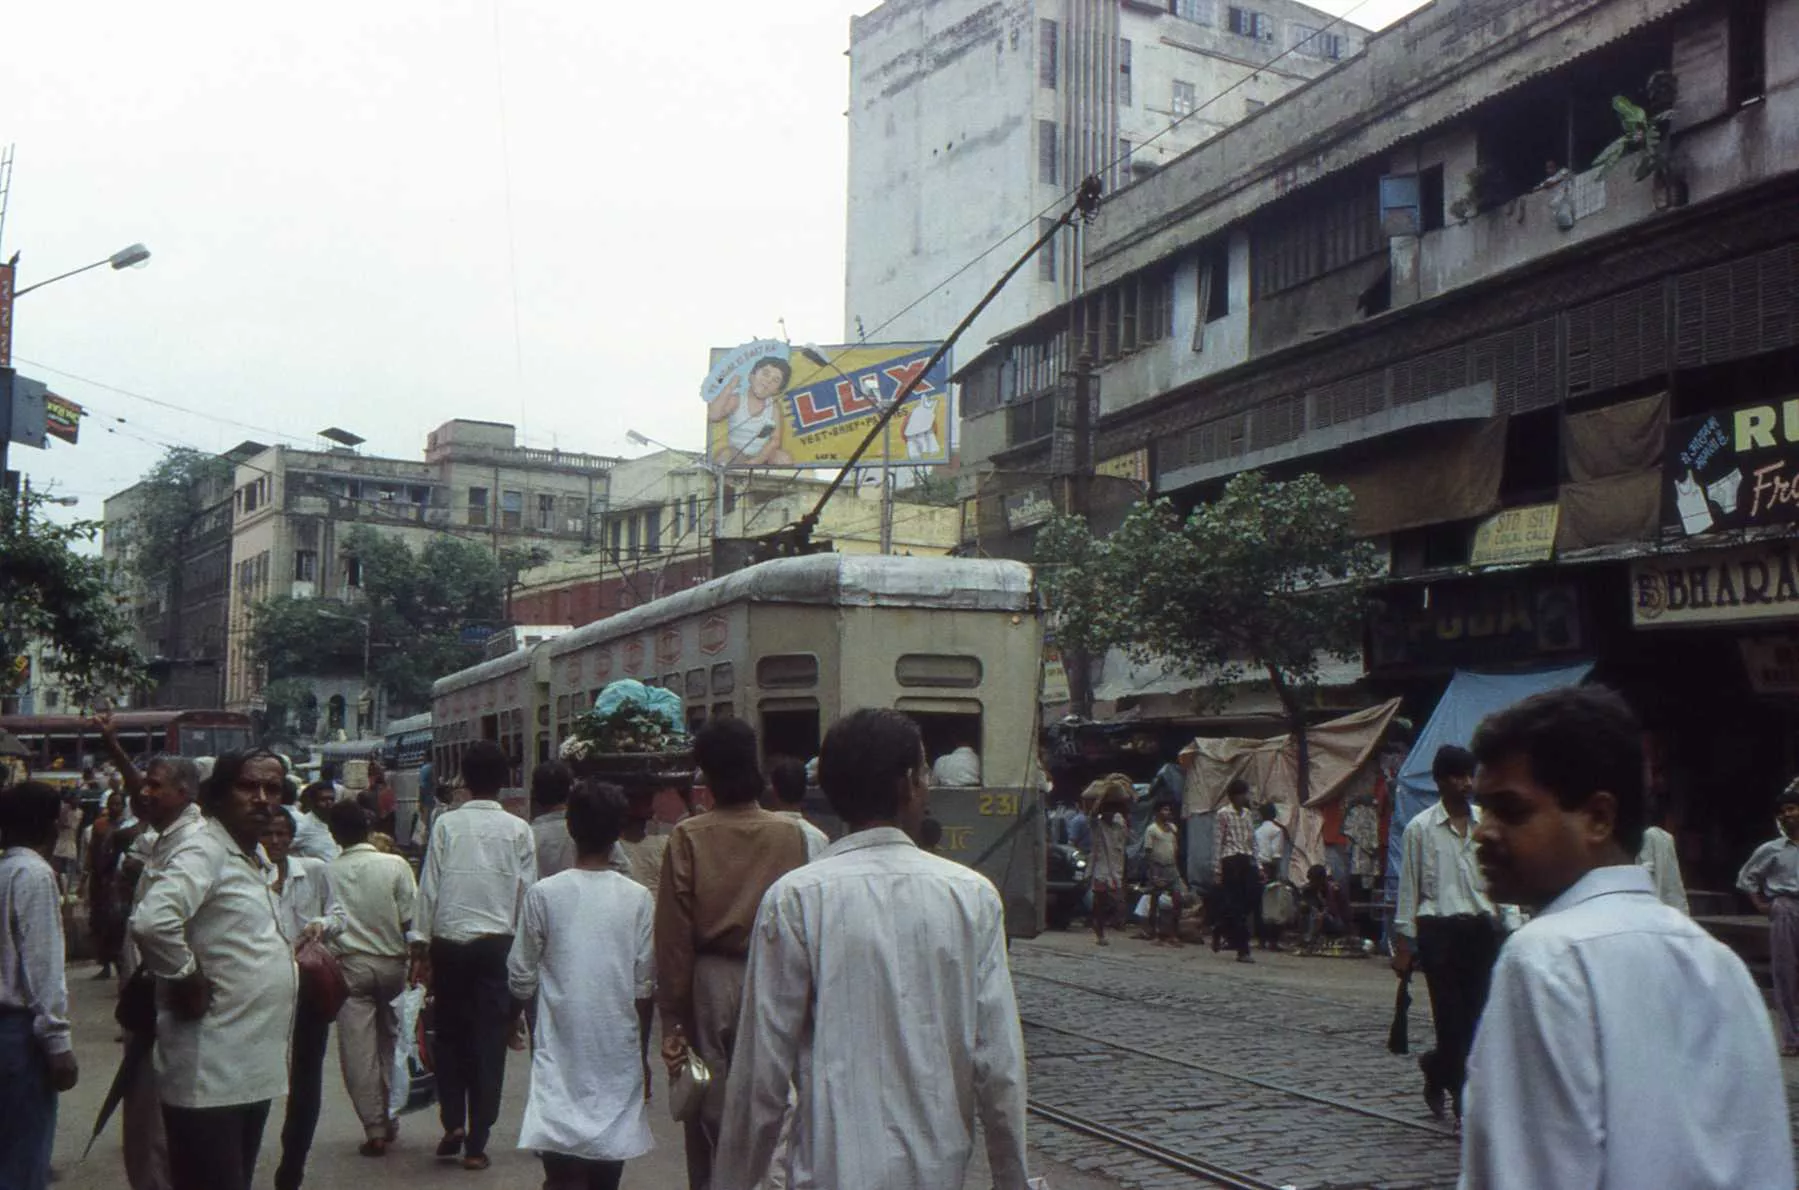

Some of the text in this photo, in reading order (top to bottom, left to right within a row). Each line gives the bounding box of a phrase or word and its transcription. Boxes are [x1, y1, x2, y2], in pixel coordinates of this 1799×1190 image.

[795, 356, 935, 428] LUX
[800, 429, 829, 446] VEST
[1665, 545, 1799, 611] BHARA
[979, 793, 1018, 816] 231
